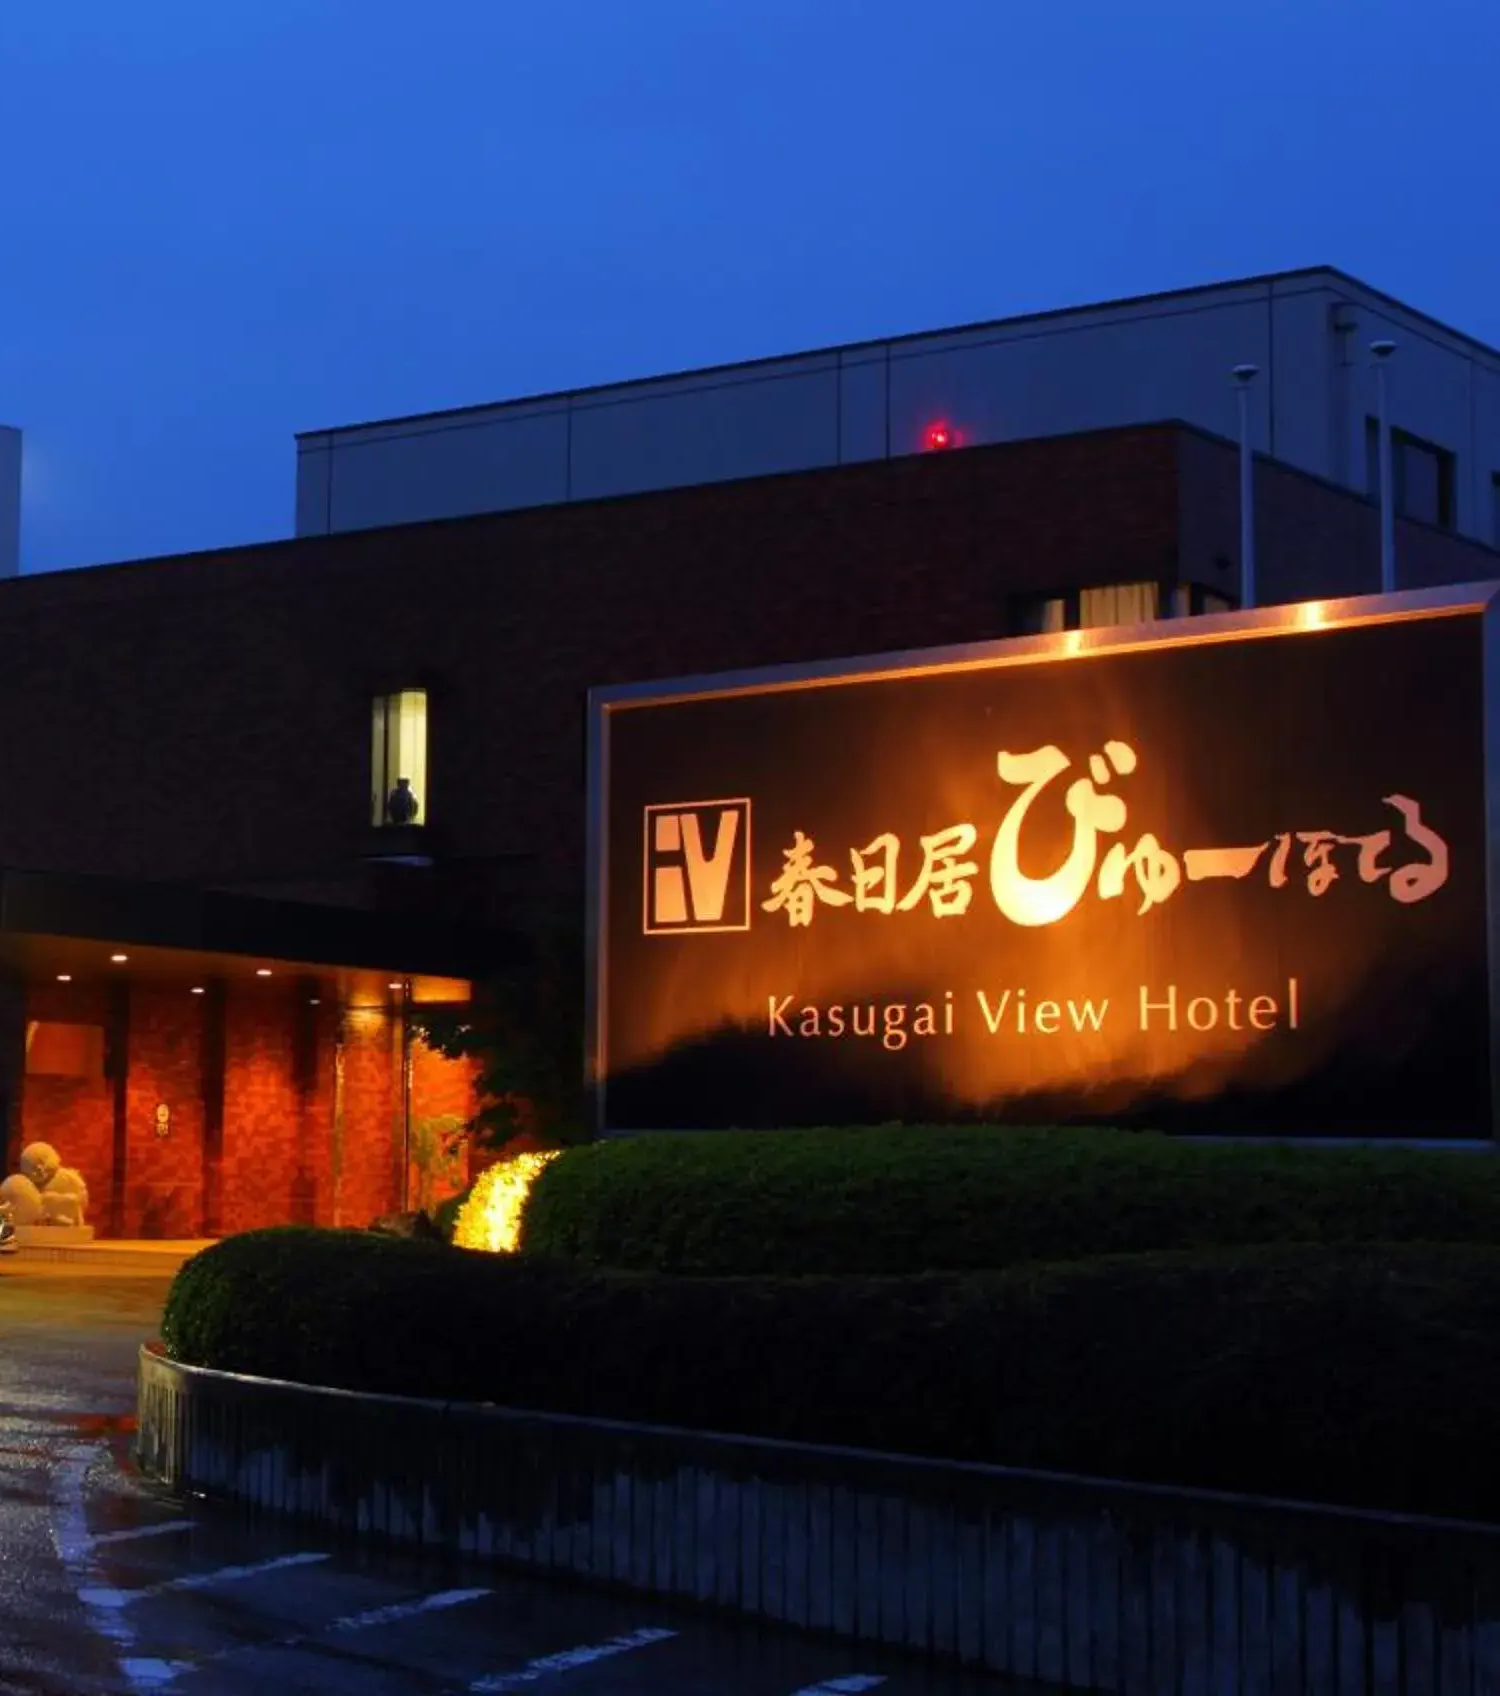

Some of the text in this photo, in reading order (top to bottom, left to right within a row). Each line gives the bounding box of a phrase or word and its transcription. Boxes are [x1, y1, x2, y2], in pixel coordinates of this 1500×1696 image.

[761, 740, 1448, 927] 春日居びゅーほてる
[768, 978, 1297, 1050] Kasugai View Hotel
